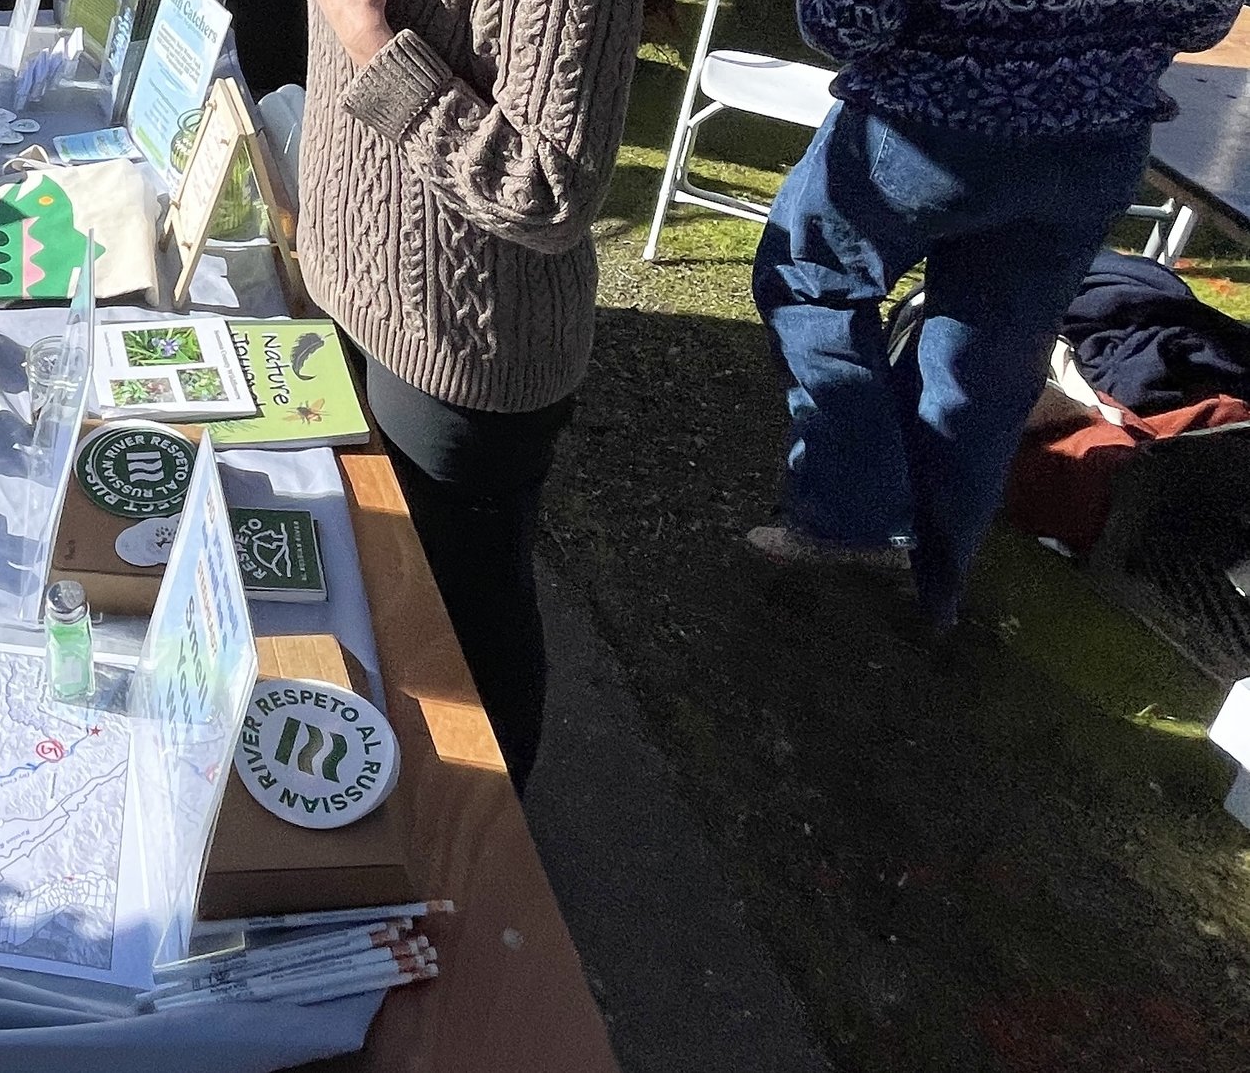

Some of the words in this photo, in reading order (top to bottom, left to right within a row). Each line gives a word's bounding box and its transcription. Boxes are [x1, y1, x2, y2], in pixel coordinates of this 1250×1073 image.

[183, 0, 218, 44] Catchers
[261, 335, 291, 406] Nature
[105, 434, 146, 459] RIVER
[149, 435, 189, 481] RESPETO
[102, 460, 154, 498] RUSSIAN
[155, 479, 179, 495] AL
[234, 518, 268, 580] RESPETO
[185, 594, 209, 712] Smell
[177, 636, 193, 734] Your
[254, 689, 359, 723] RESPETO
[243, 715, 279, 790] RIVER
[355, 726, 382, 755] AL
[278, 760, 382, 814] RUSSIAN
